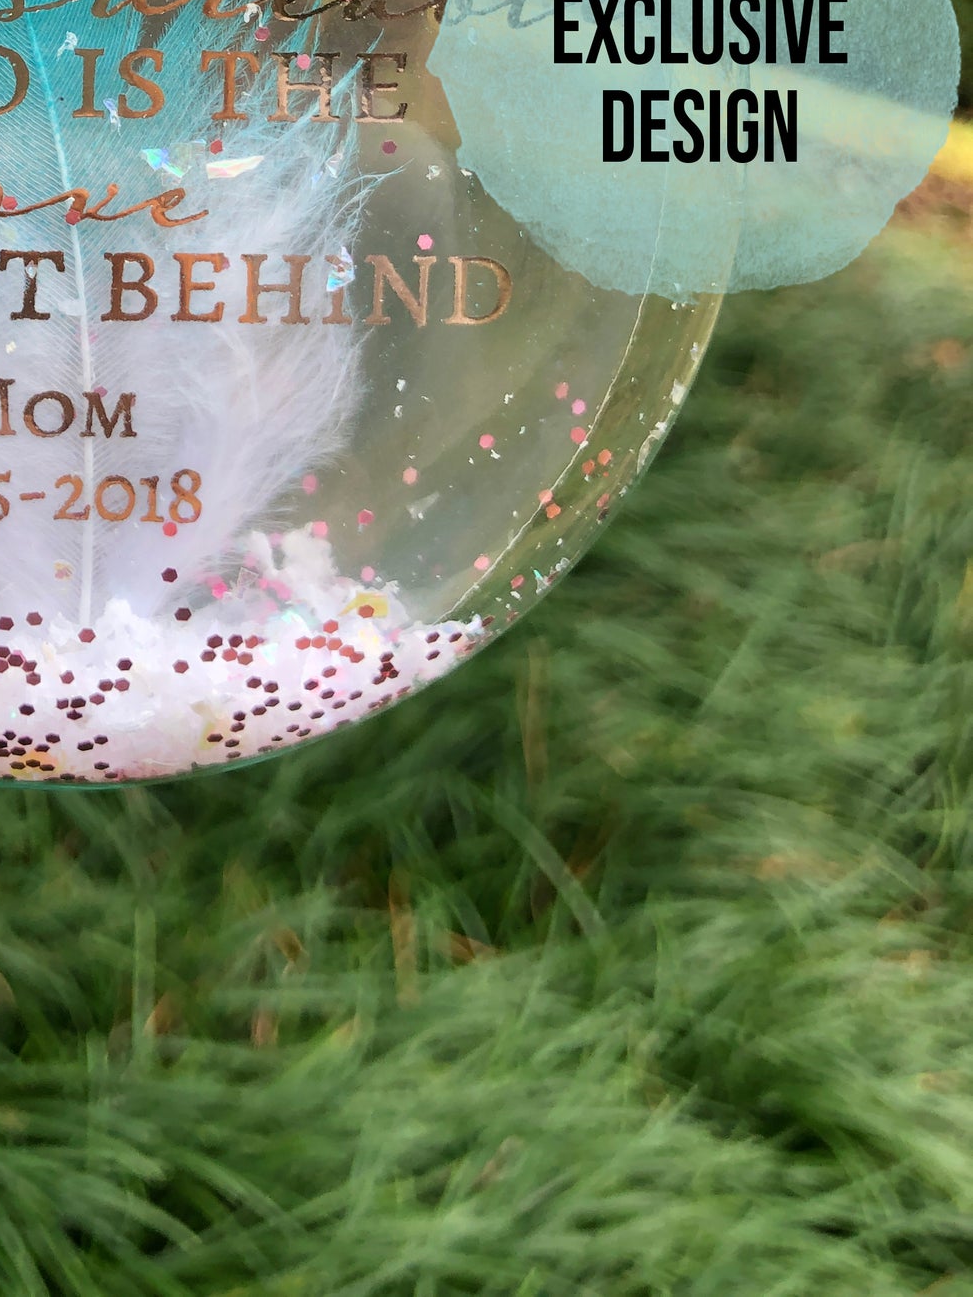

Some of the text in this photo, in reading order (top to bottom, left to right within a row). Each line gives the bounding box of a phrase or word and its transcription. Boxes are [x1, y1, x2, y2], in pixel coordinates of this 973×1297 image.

[71, 47, 166, 119] IS
[199, 50, 408, 124] THE
[100, 251, 513, 327] BEHIND
